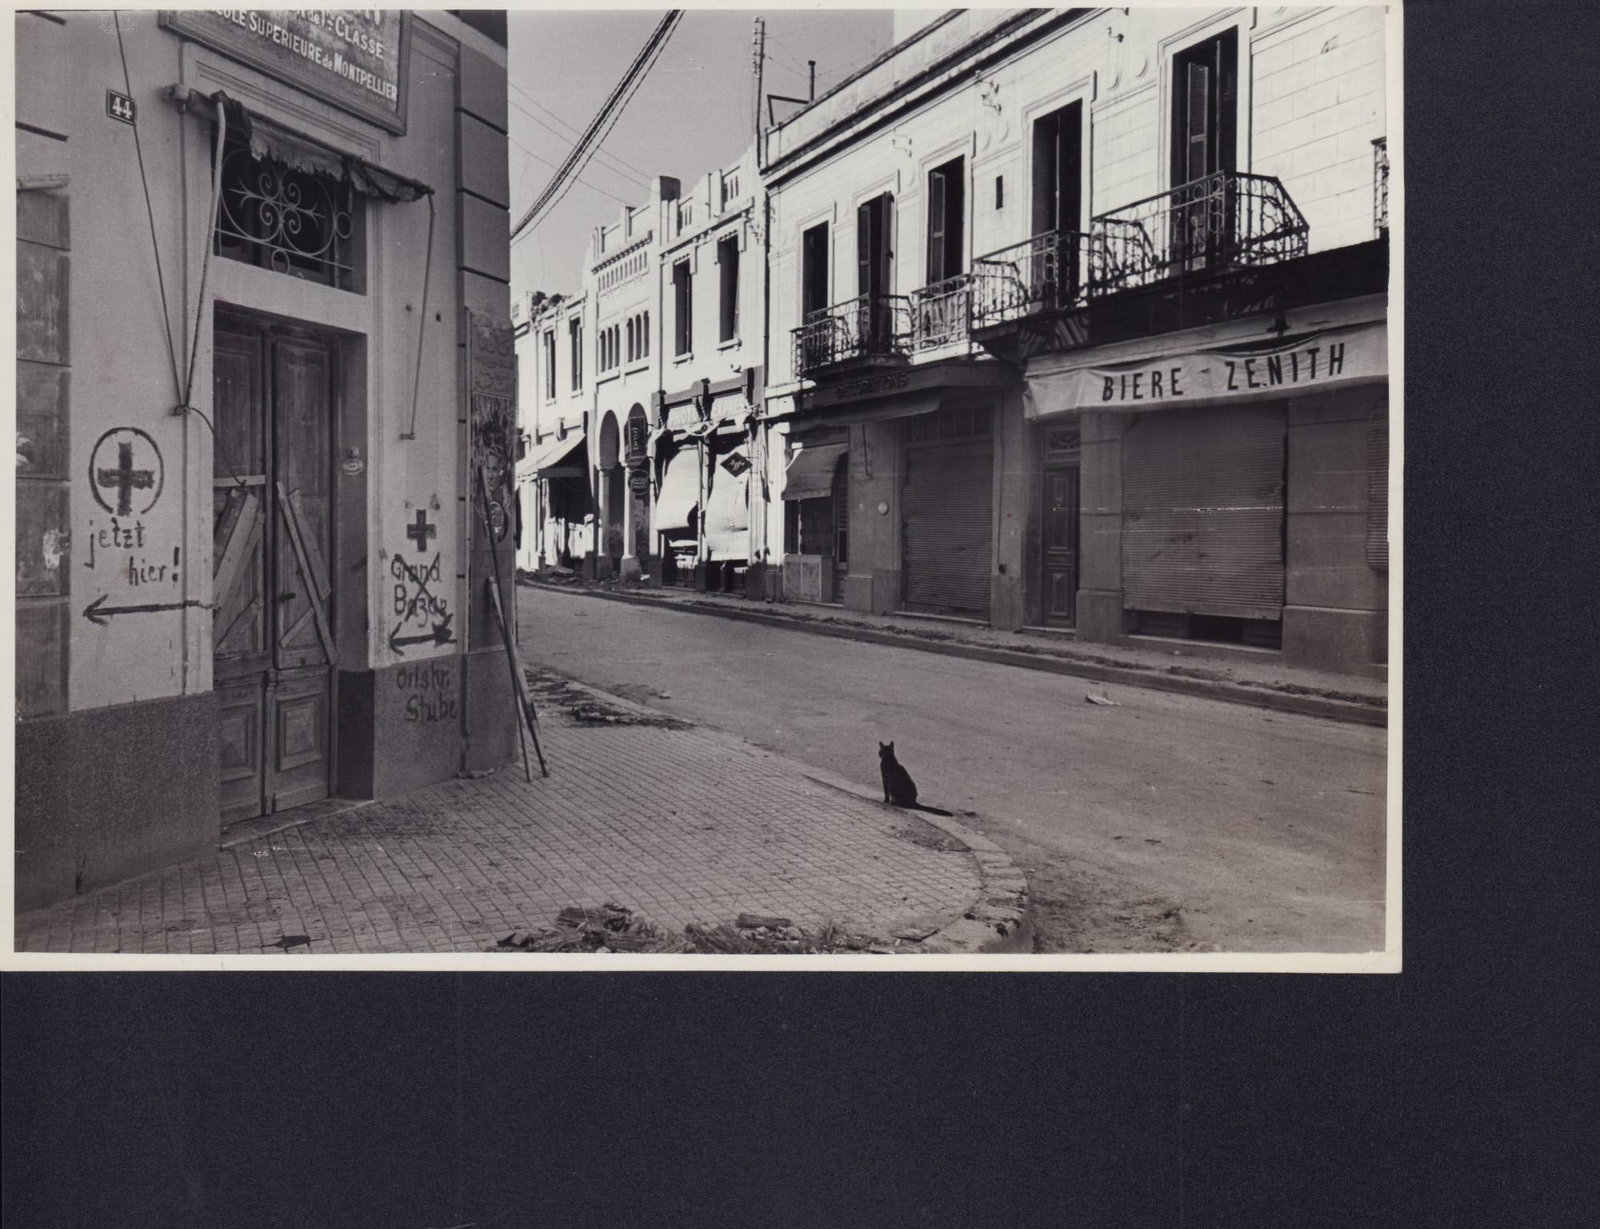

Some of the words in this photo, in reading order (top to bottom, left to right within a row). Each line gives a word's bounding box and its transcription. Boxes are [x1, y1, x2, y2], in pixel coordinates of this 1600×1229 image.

[249, 11, 322, 64] SUPERIEURE
[322, 54, 333, 70] de
[333, 53, 398, 101] MONTPELLIER
[335, 16, 385, 60] CLASSE
[112, 97, 132, 119] 44
[1102, 367, 1184, 401] BIERE
[1225, 343, 1345, 391] ZENITH
[84, 517, 145, 570] jetzt
[129, 546, 180, 586] hier!
[404, 691, 458, 725] Stube
